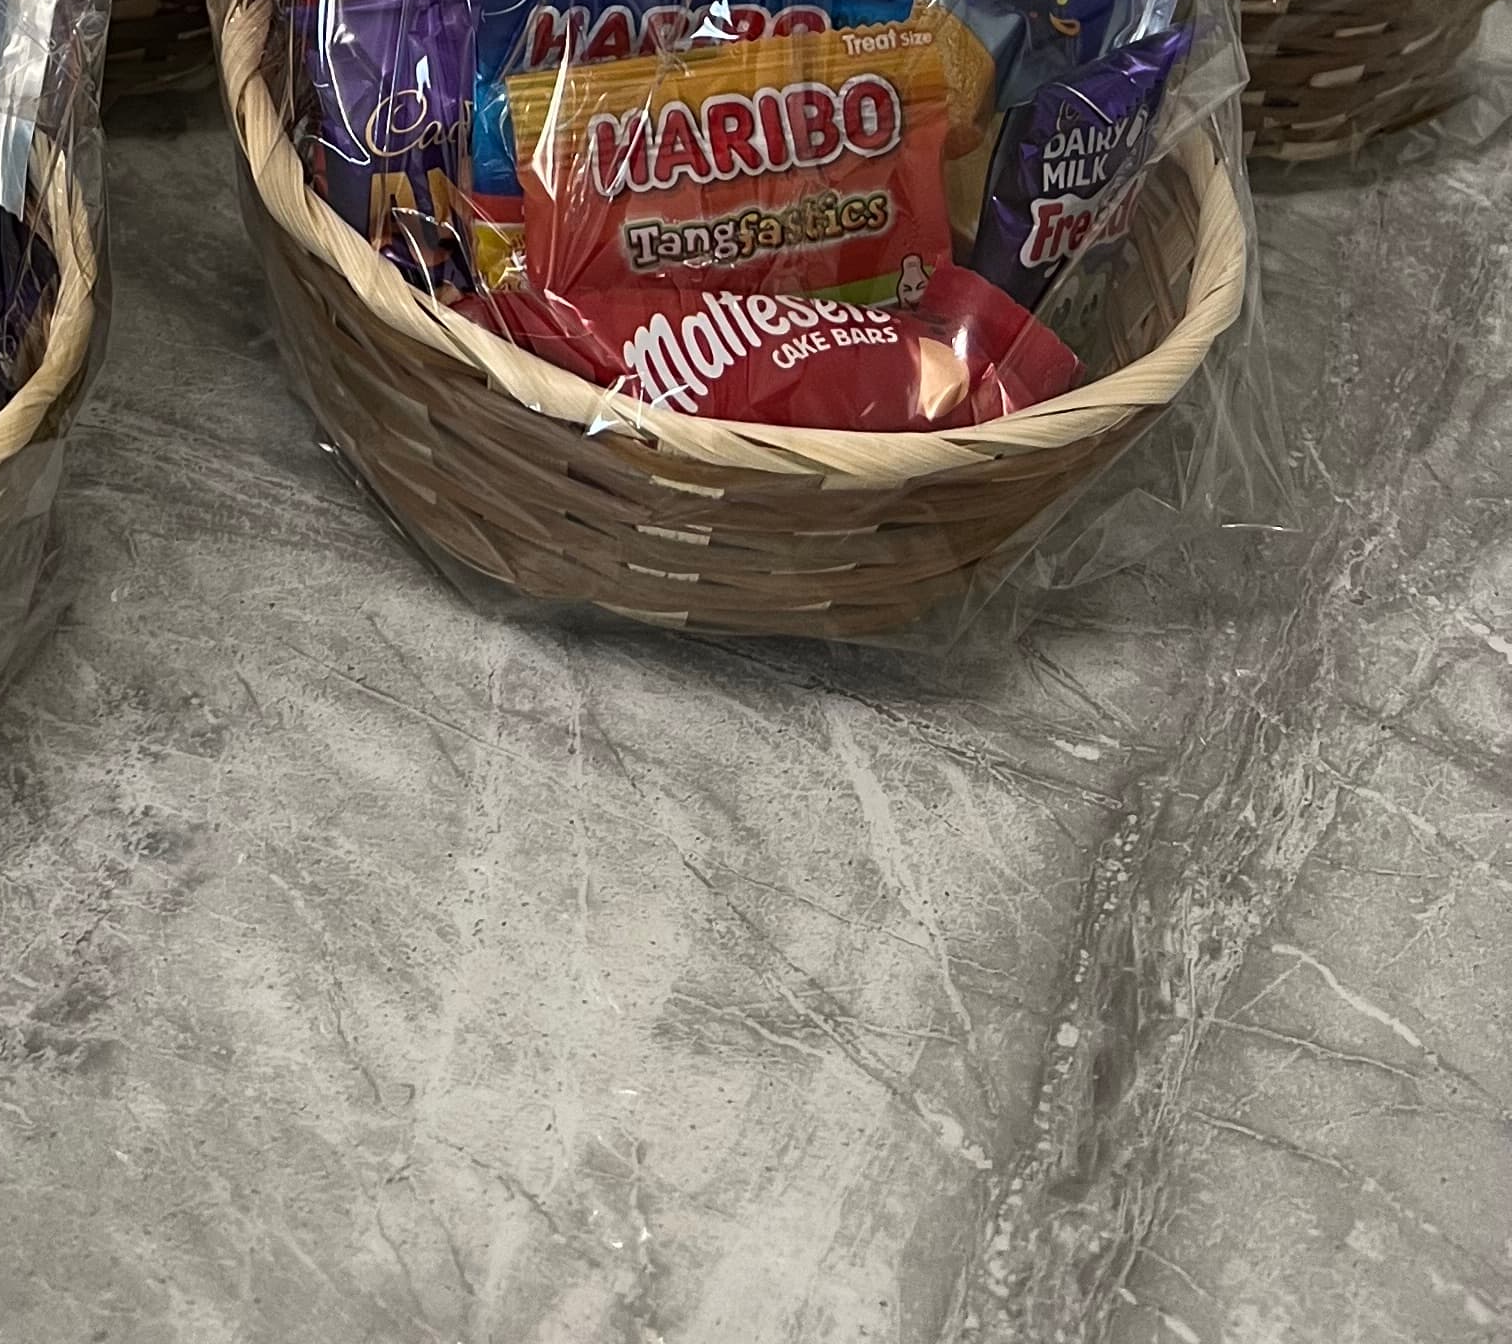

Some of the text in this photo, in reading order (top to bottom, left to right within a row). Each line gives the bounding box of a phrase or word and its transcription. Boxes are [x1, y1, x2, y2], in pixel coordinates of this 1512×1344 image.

[842, 27, 934, 56] Treat size
[590, 73, 902, 197] HARIBO
[1043, 117, 1128, 160] DAIRY
[1042, 153, 1108, 193] MILK
[624, 191, 890, 268] Tangfastics
[772, 325, 899, 369] CAKE BARS
